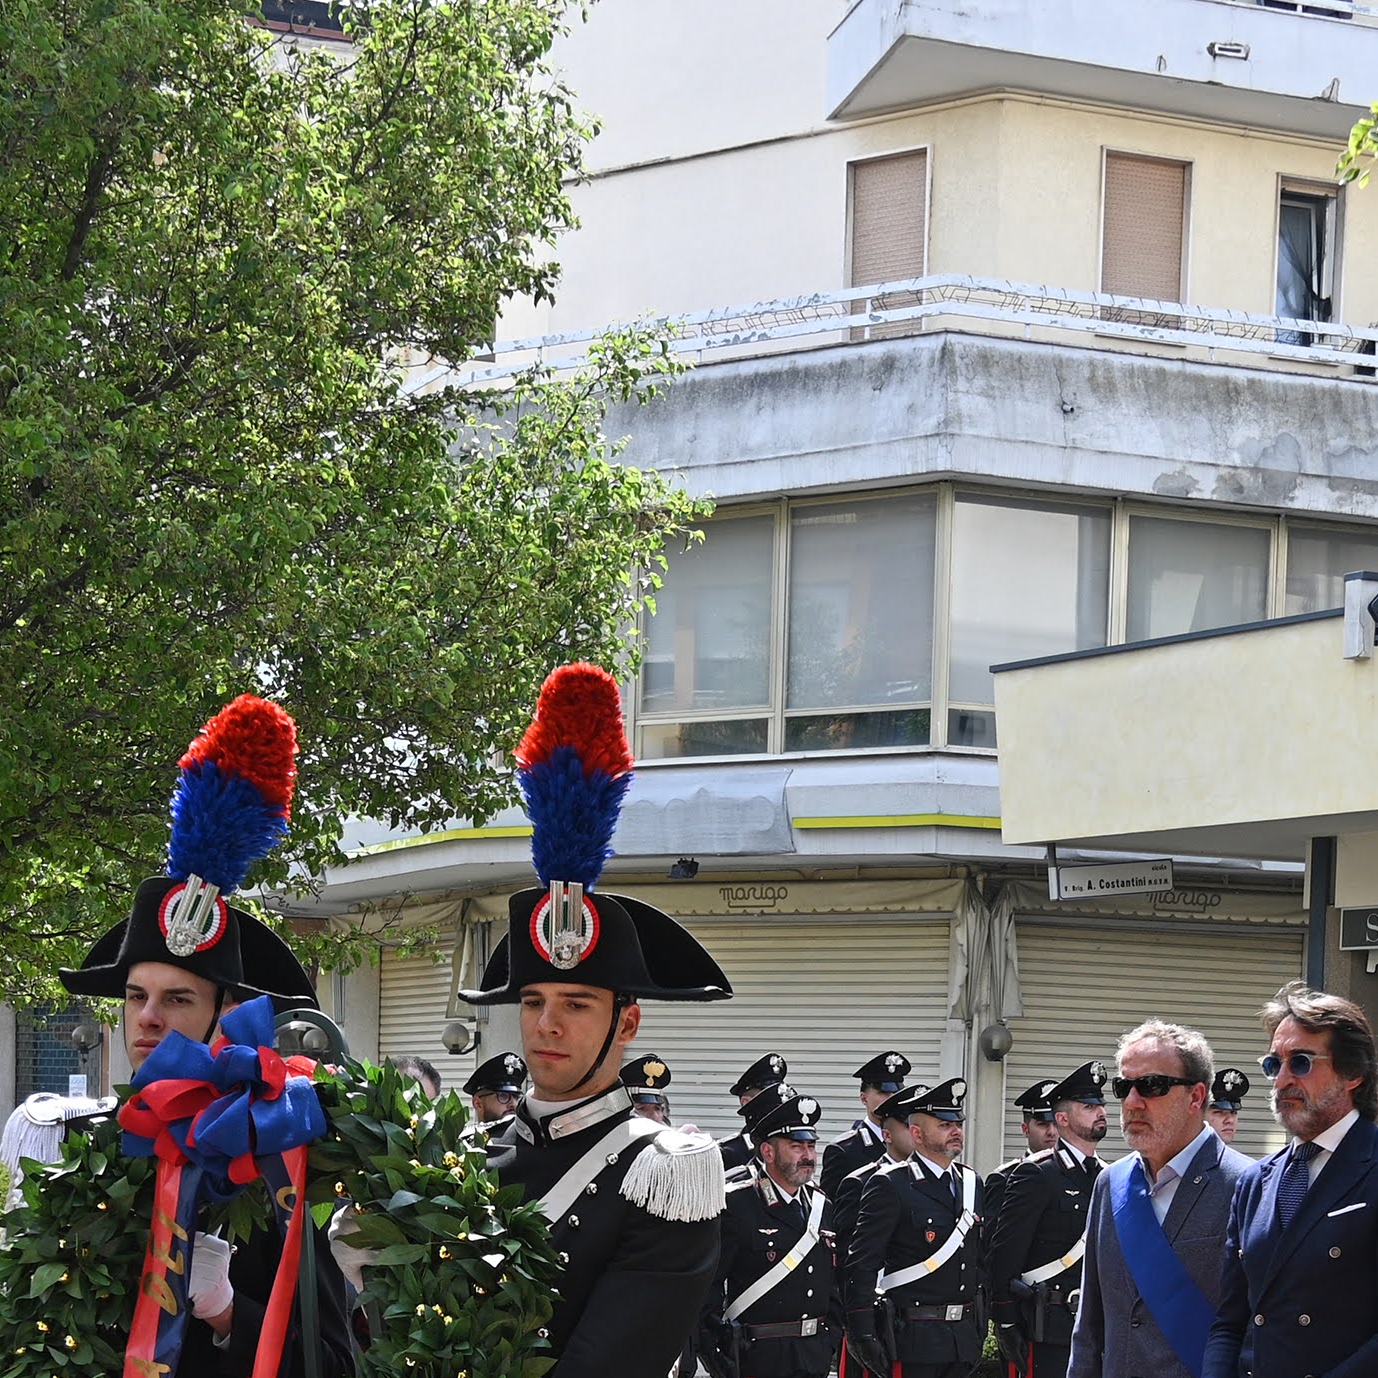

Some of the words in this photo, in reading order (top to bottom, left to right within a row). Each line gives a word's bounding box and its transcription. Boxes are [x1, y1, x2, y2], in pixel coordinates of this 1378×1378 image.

[1087, 879, 1096, 891] A.
[1098, 876, 1147, 890] Costantini
[143, 1208, 190, 1317] DEI
